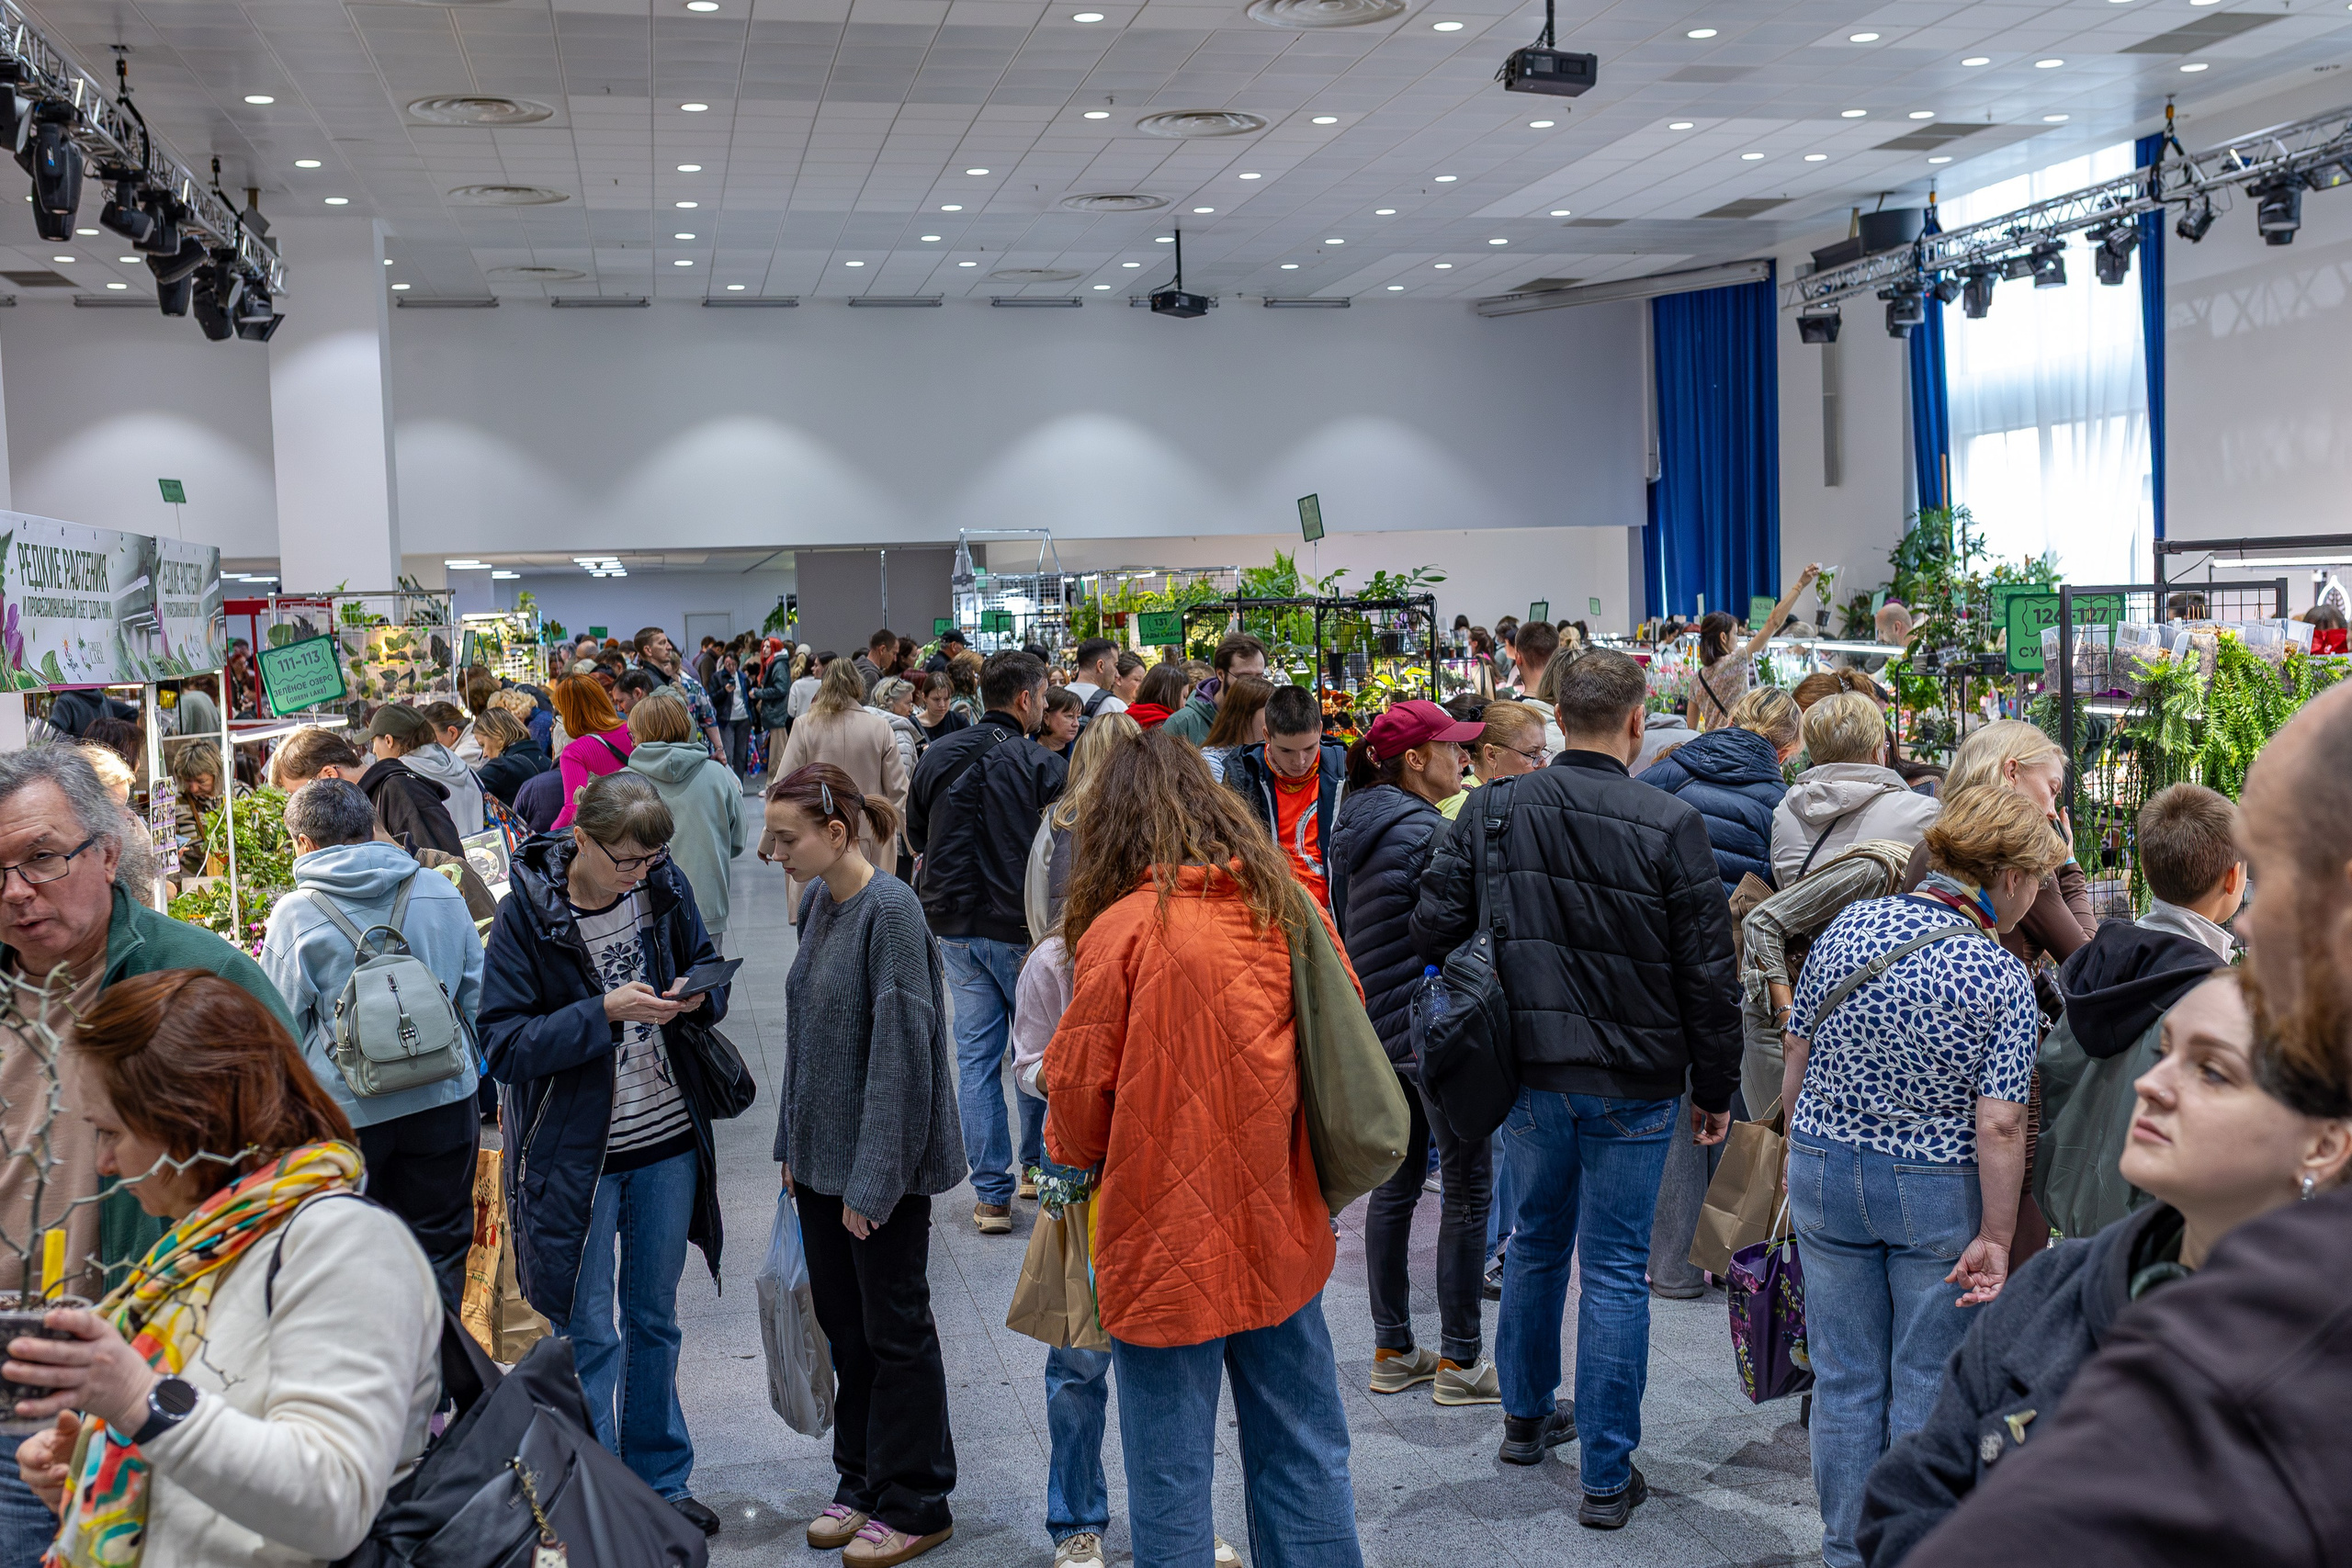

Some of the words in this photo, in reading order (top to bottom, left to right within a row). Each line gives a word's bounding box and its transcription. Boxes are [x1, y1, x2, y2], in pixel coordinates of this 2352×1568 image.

[17, 542, 62, 592] РЕДКИЕ
[62, 548, 109, 592] РАСТЕНИЯ
[1155, 617, 1167, 626] 131
[277, 649, 321, 673] 111-113
[274, 682, 307, 698] ЗЕЛЁНОЕ
[309, 673, 334, 687] ОЗЕРО
[310, 684, 327, 697] LAKE)
